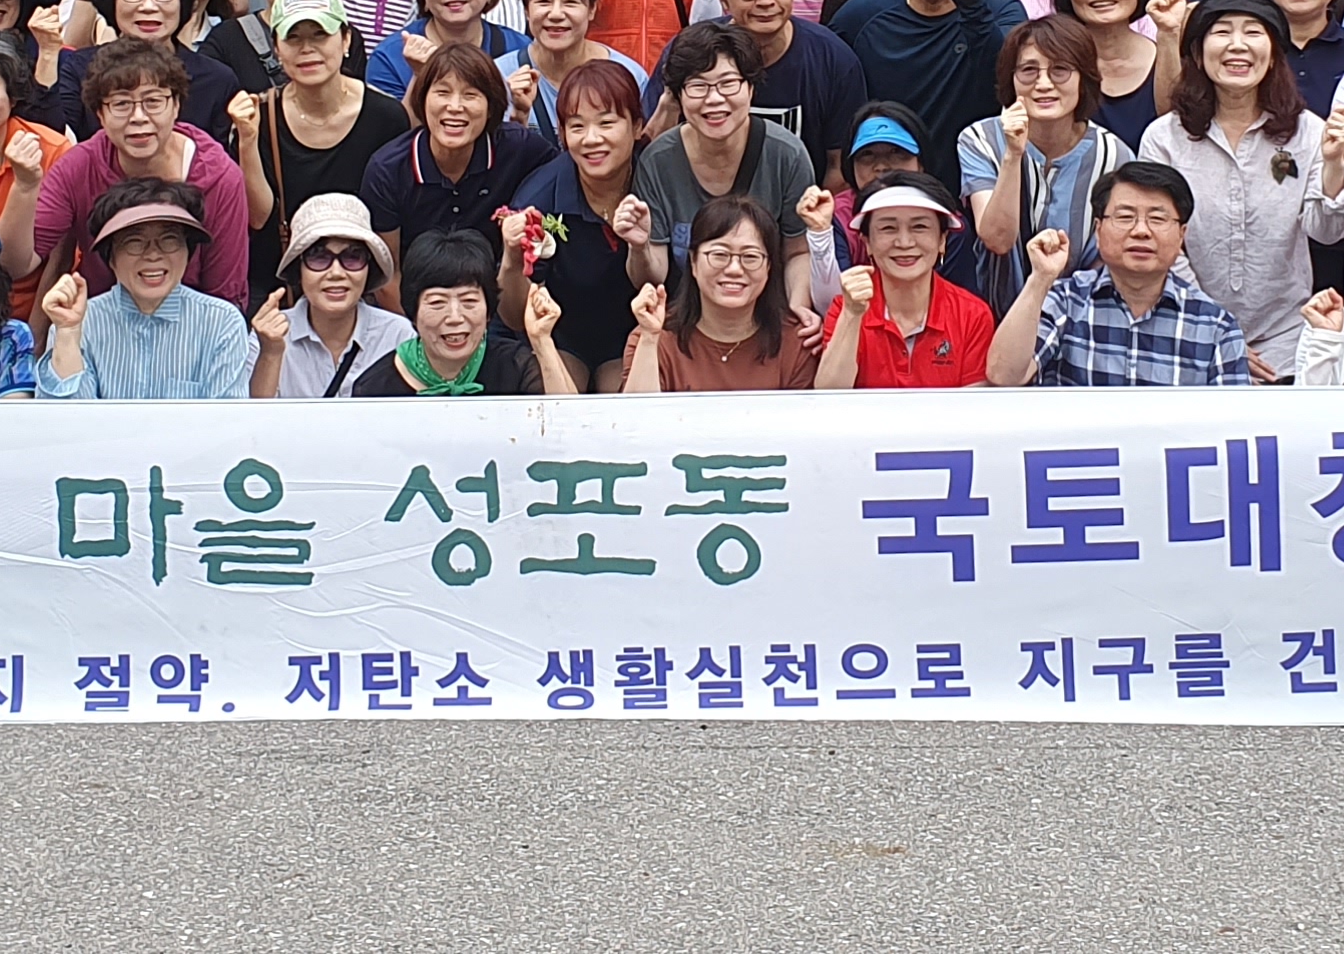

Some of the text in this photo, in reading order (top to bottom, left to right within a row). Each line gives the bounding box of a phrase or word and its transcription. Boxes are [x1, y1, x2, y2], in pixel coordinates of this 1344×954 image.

[55, 457, 318, 587] 마을
[384, 453, 790, 587] 성포동
[74, 653, 236, 714] 절약.
[285, 650, 493, 712] 저탄소
[537, 643, 972, 710] 생활실천으로
[1019, 632, 1232, 702] 지구를
